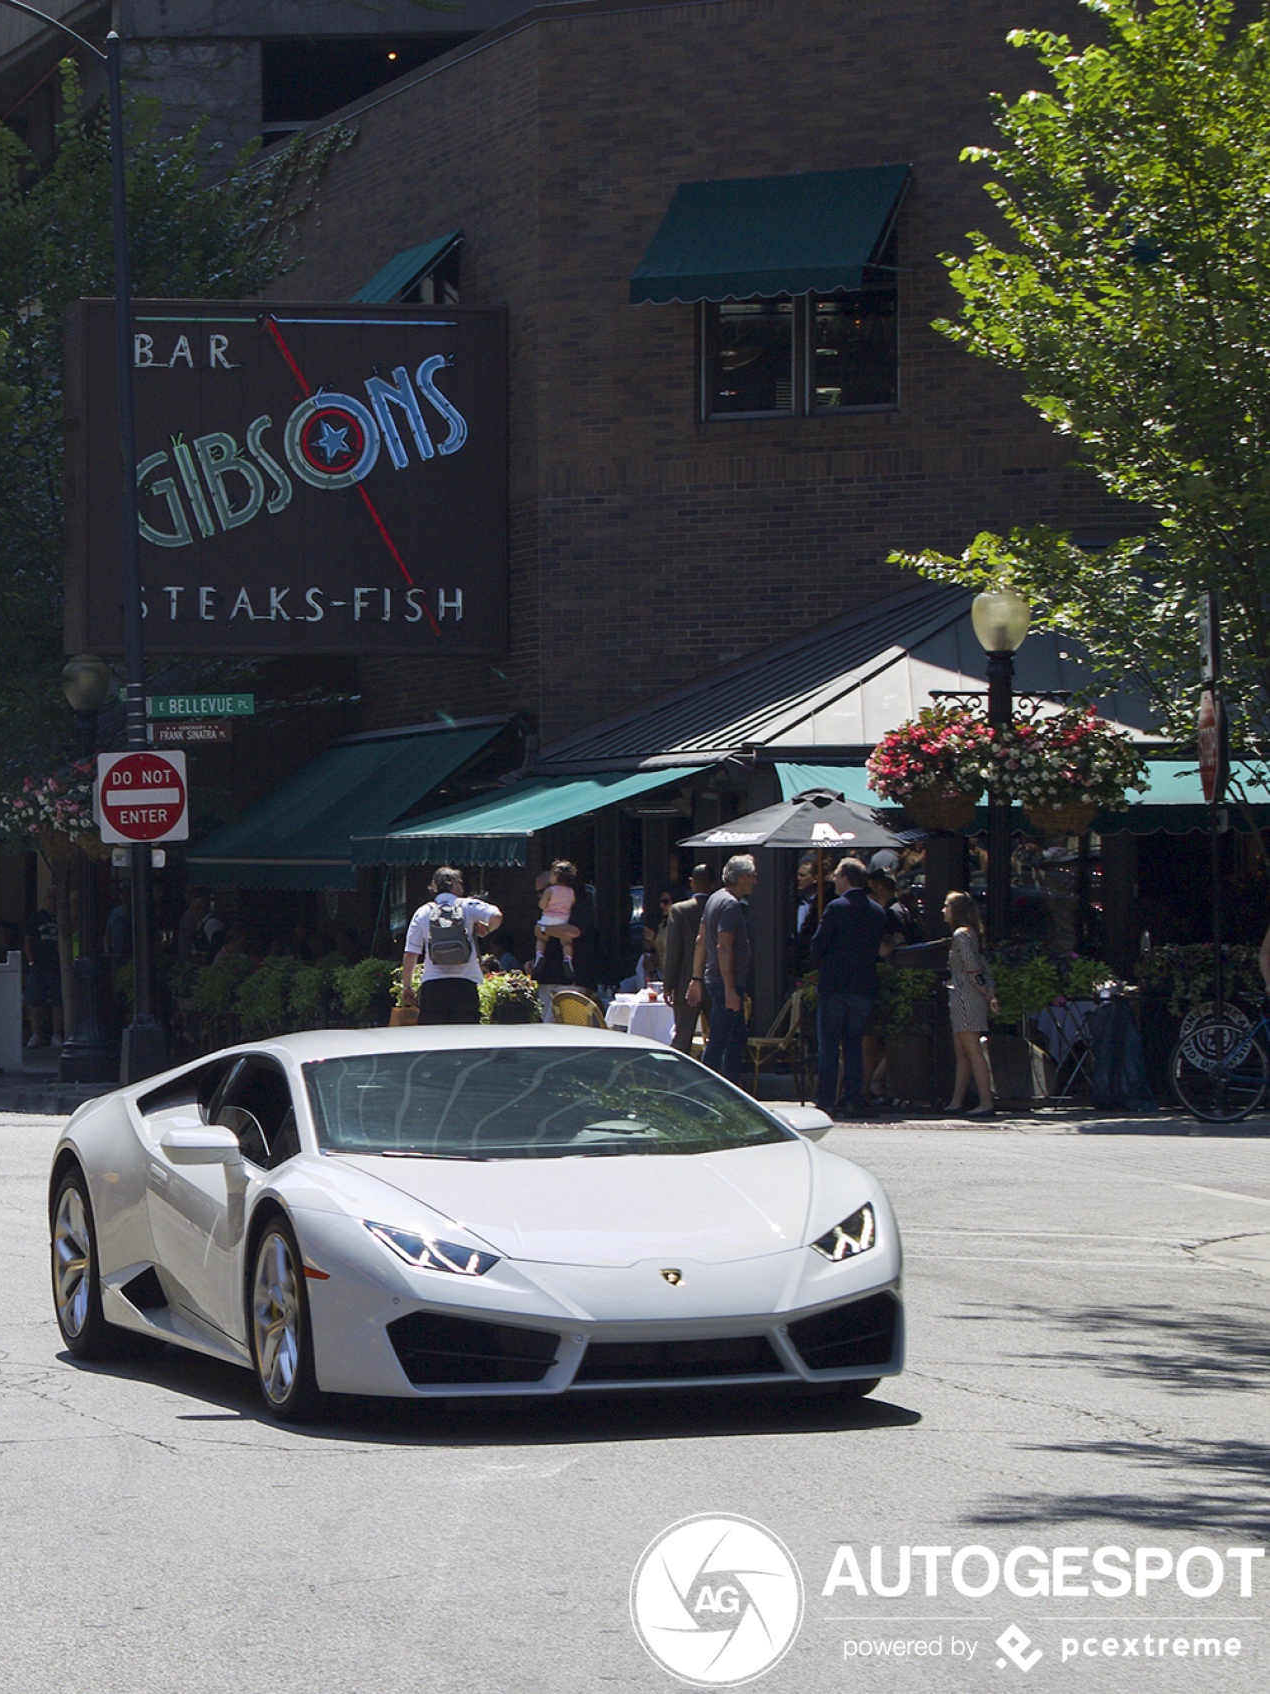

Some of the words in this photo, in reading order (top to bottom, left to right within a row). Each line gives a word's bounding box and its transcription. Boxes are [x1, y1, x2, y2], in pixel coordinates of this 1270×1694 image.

[134, 333, 233, 369] BAR
[136, 354, 468, 548] GIBSONS
[159, 701, 164, 711] E
[169, 697, 233, 714] BELLEVUE
[238, 700, 248, 709] PL
[159, 730, 184, 740] FRANK
[187, 729, 216, 740] SINATRA
[112, 771, 132, 785] DO
[141, 770, 171, 784] NOT
[120, 809, 167, 824] ENTER
